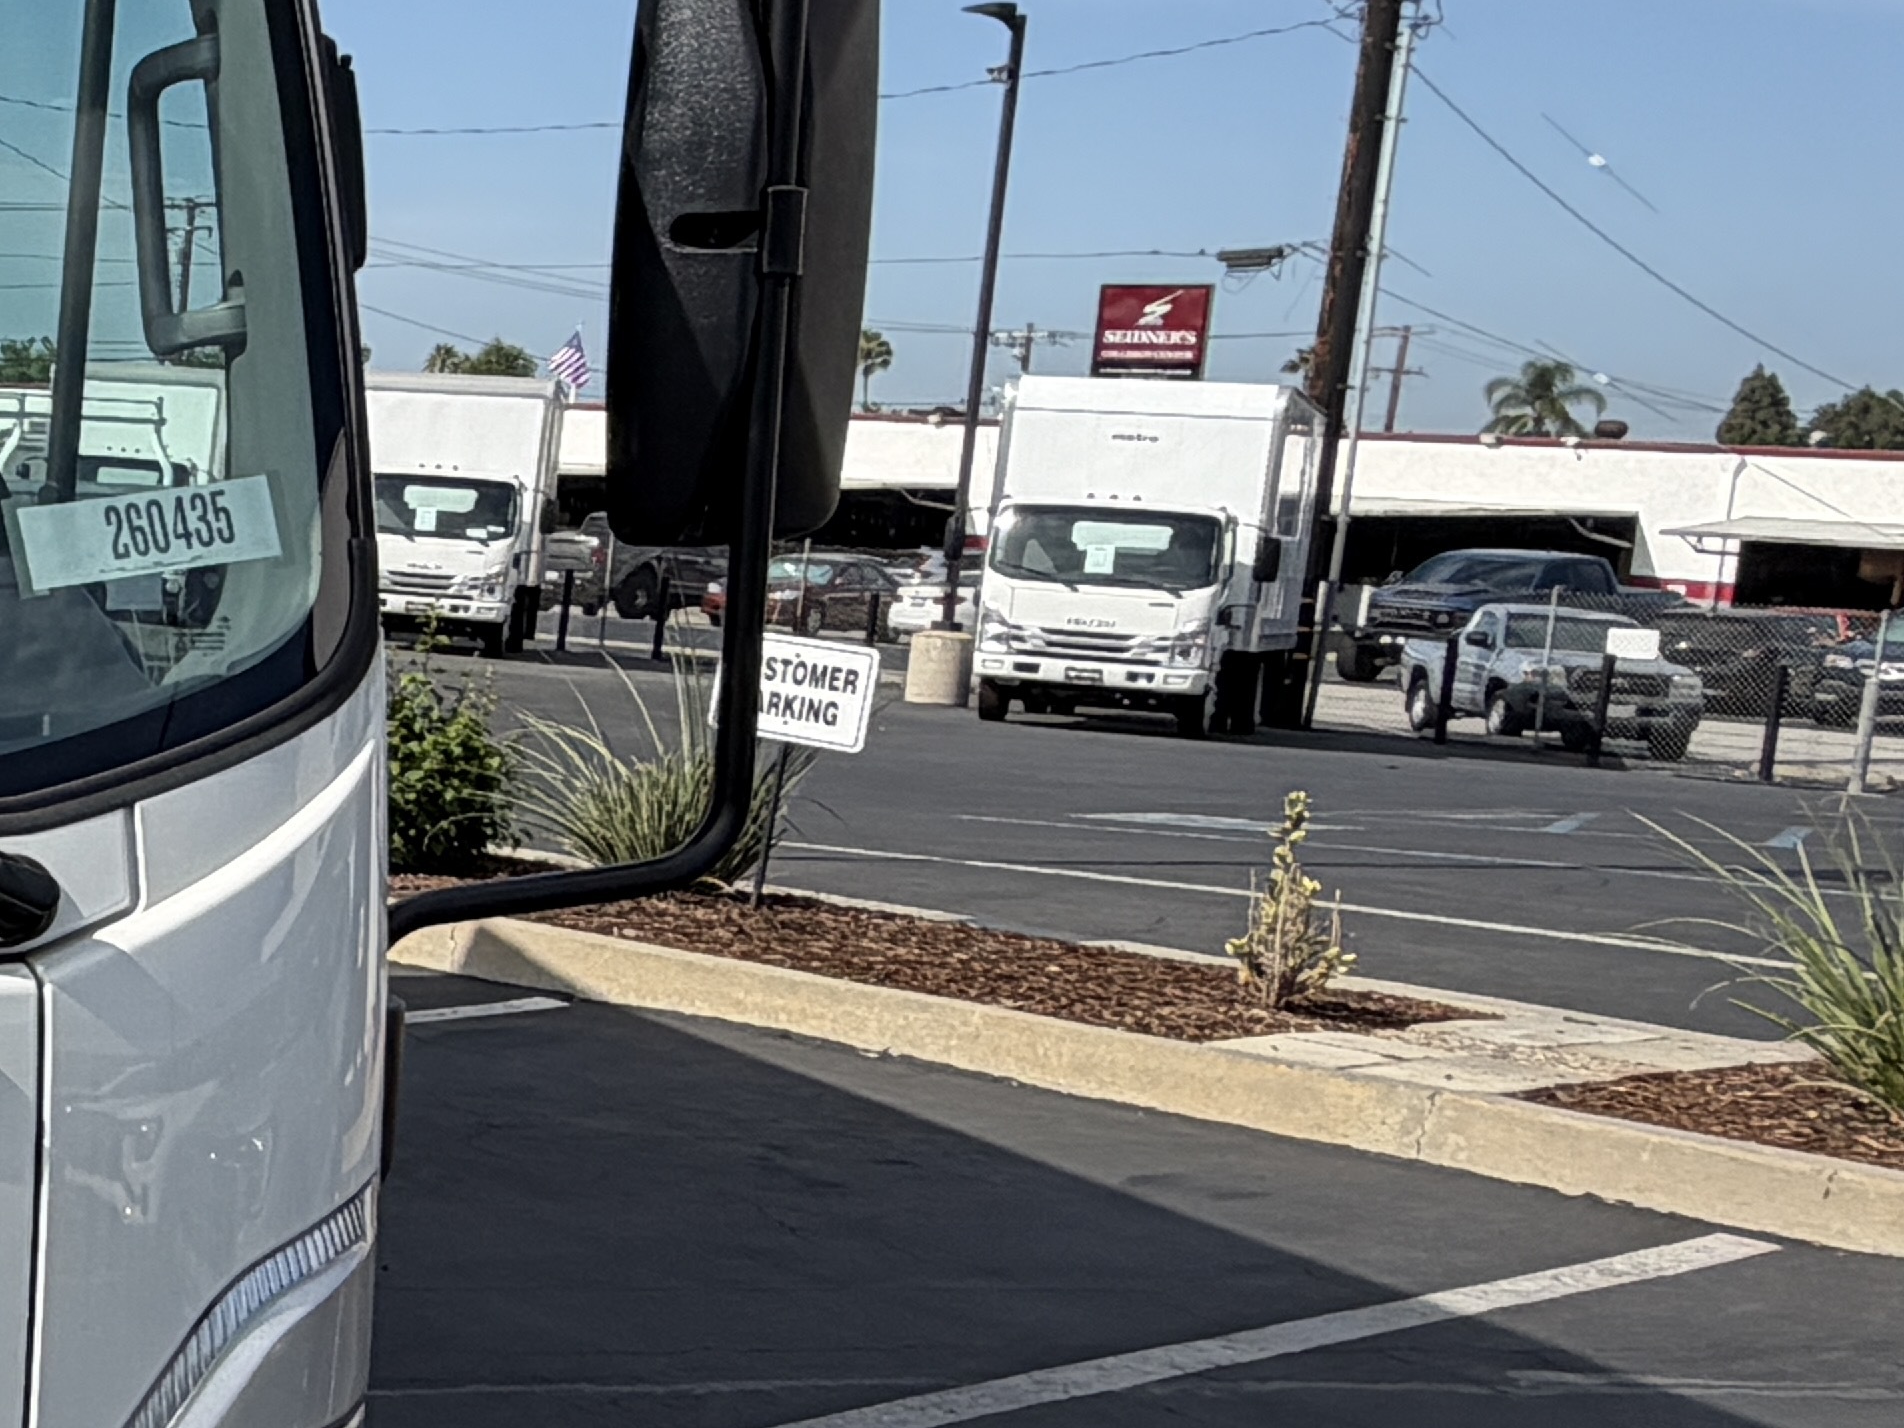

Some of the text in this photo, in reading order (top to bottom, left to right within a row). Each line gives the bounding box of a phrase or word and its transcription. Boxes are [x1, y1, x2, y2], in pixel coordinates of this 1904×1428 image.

[103, 488, 236, 561] 260435
[763, 656, 860, 695] STOMER
[760, 690, 840, 727] RKING
